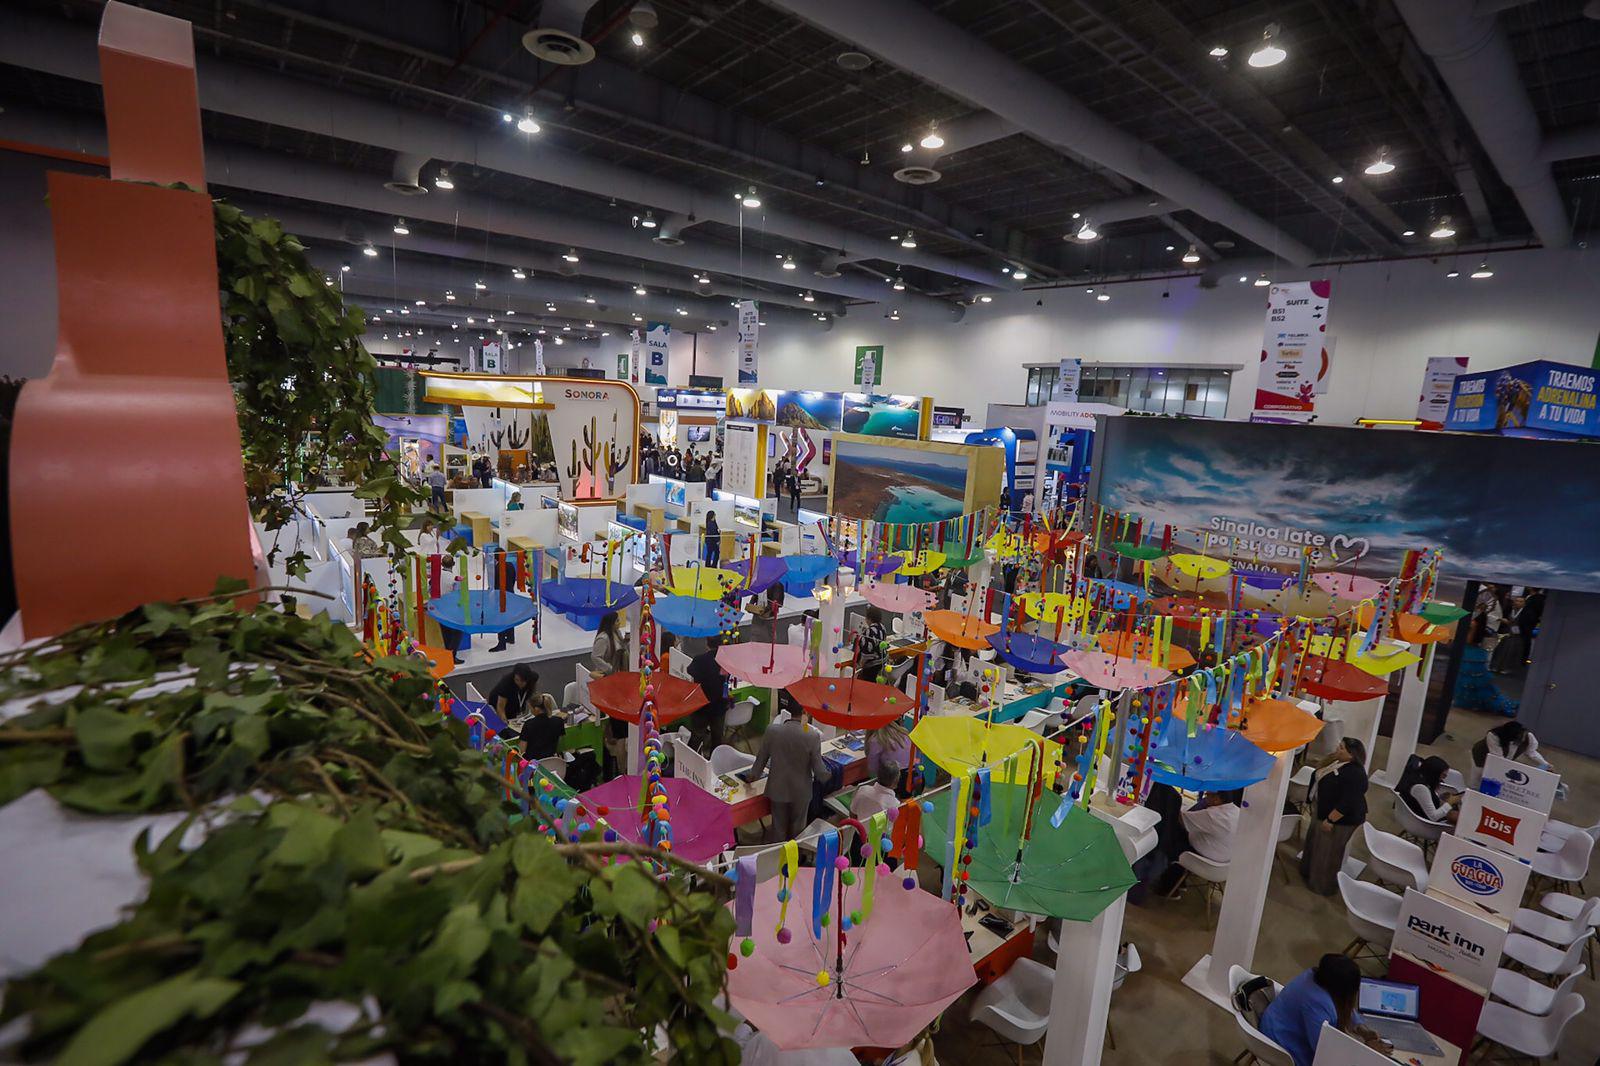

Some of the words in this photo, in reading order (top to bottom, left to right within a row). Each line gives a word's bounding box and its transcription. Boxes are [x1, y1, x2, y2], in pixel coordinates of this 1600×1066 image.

[649, 340, 668, 348] SALA
[487, 359, 496, 369] B
[652, 352, 664, 366] B
[1549, 371, 1595, 392] TRAEMOS
[565, 389, 609, 400] SONORA
[1537, 387, 1597, 409] ADRENALINA
[1538, 404, 1547, 419] A
[1549, 405, 1563, 422] TU
[1564, 408, 1587, 425] VIDA
[1211, 517, 1279, 539] Sinaloa
[1284, 526, 1326, 546] late
[1208, 533, 1237, 547] po
[1263, 543, 1323, 561] gene
[1484, 815, 1512, 834] ibis
[1473, 860, 1483, 869] LA
[1451, 861, 1502, 890] GUAGUA
[1407, 914, 1451, 942] park
[1454, 932, 1485, 957] inn
